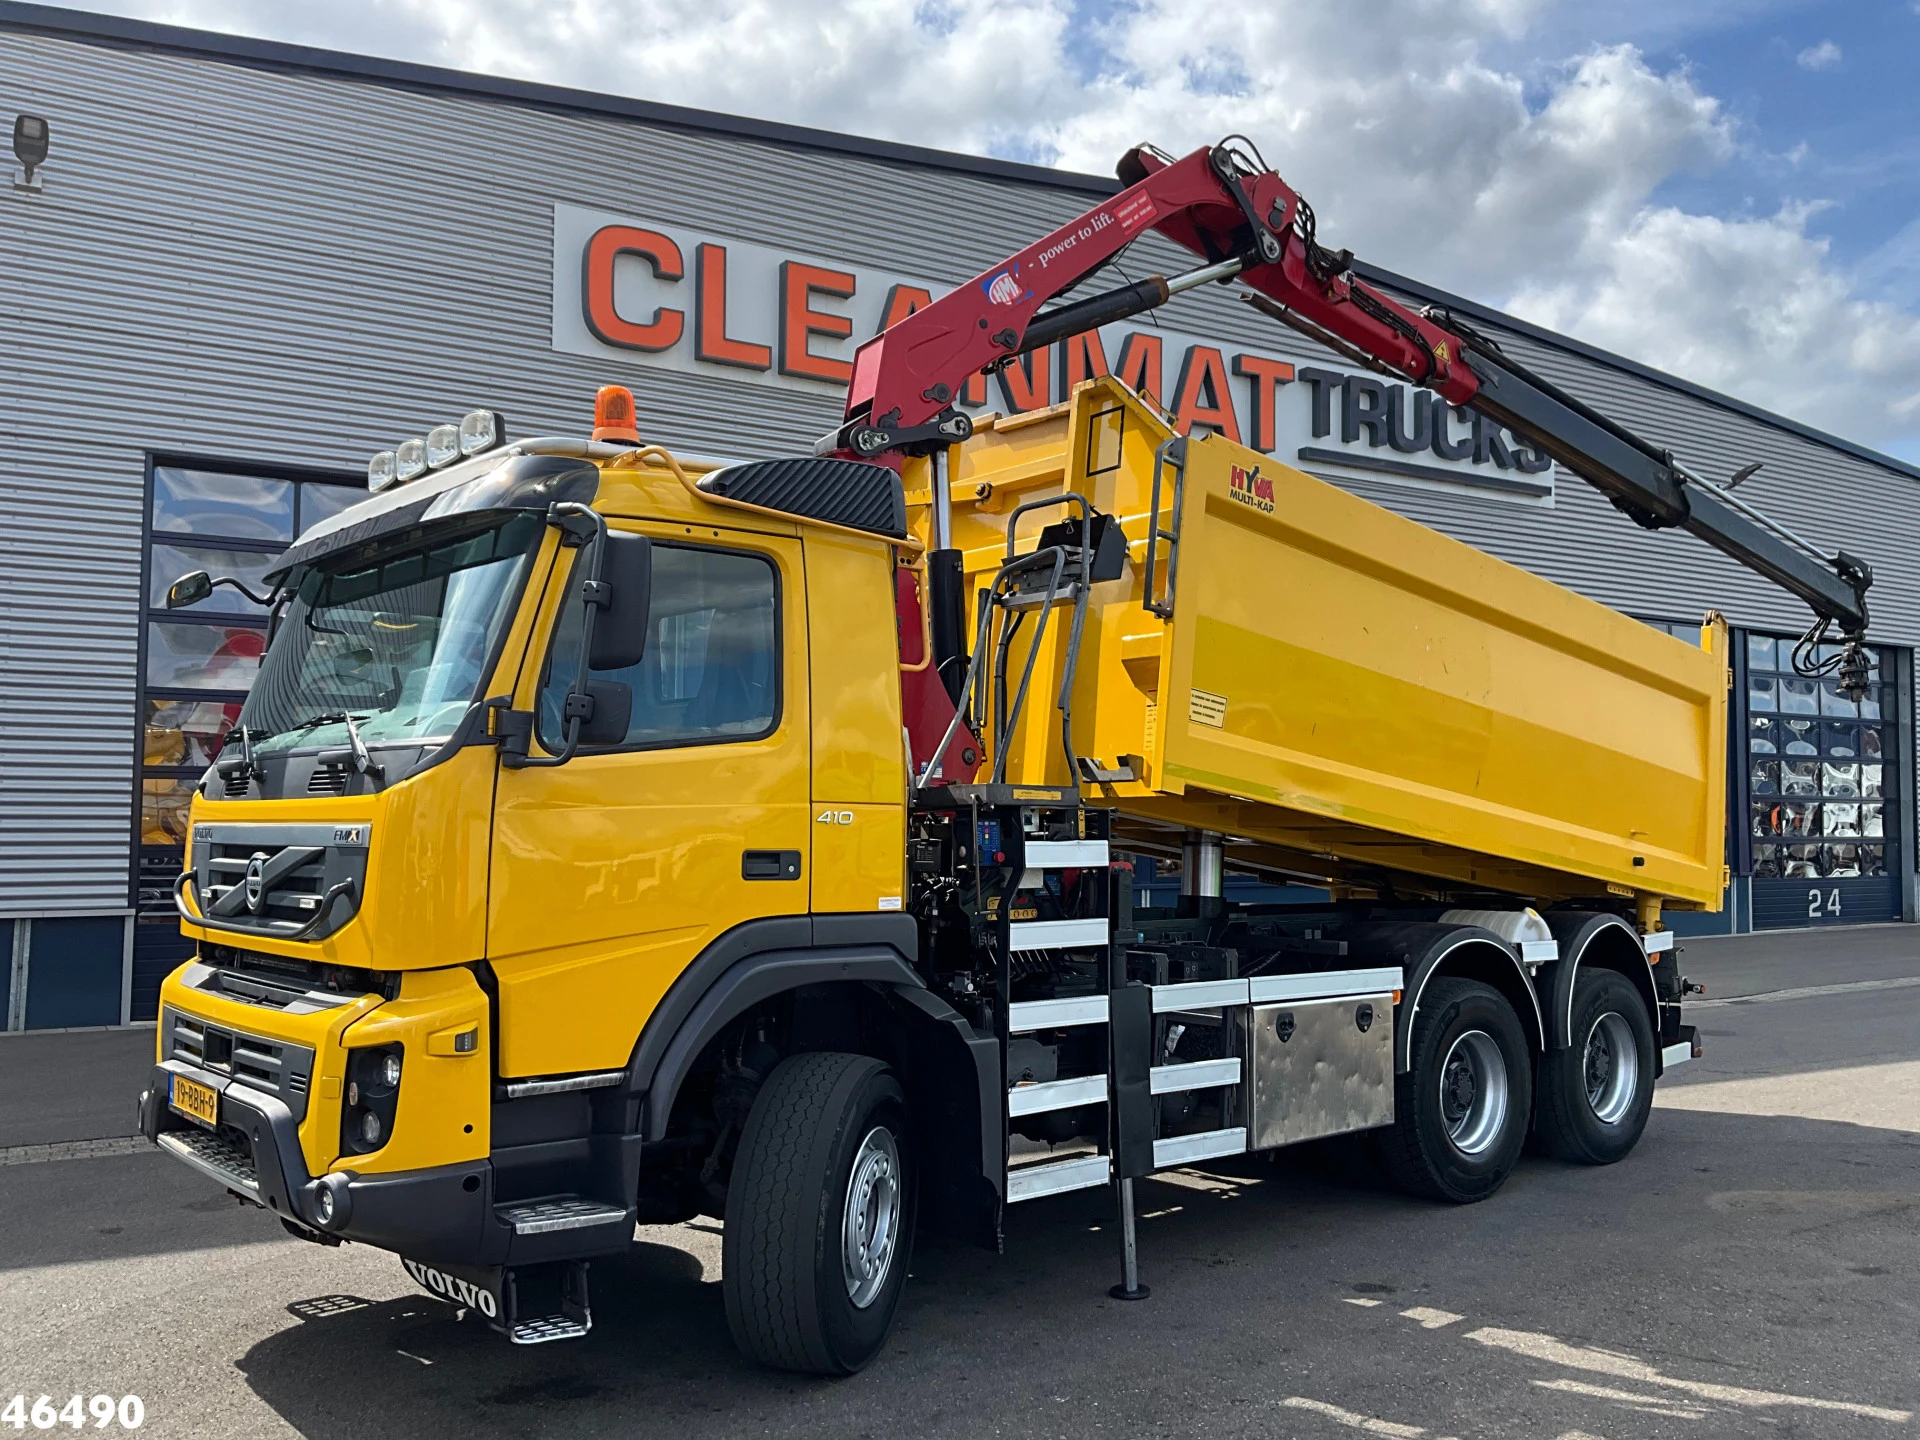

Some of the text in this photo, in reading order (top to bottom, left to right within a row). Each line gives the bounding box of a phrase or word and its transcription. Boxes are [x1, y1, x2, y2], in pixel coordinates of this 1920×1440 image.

[1038, 235, 1077, 267] power
[1078, 228, 1092, 240] to
[1090, 212, 1115, 232] lift.
[1231, 465, 1275, 503] HYVA
[1230, 489, 1274, 513] MULTI-KAP
[816, 811, 853, 825] 410
[333, 827, 361, 843] FMX
[1809, 888, 1841, 917] 24
[176, 1080, 215, 1118] 19-BBH-9
[404, 1258, 497, 1318] VOLVO
